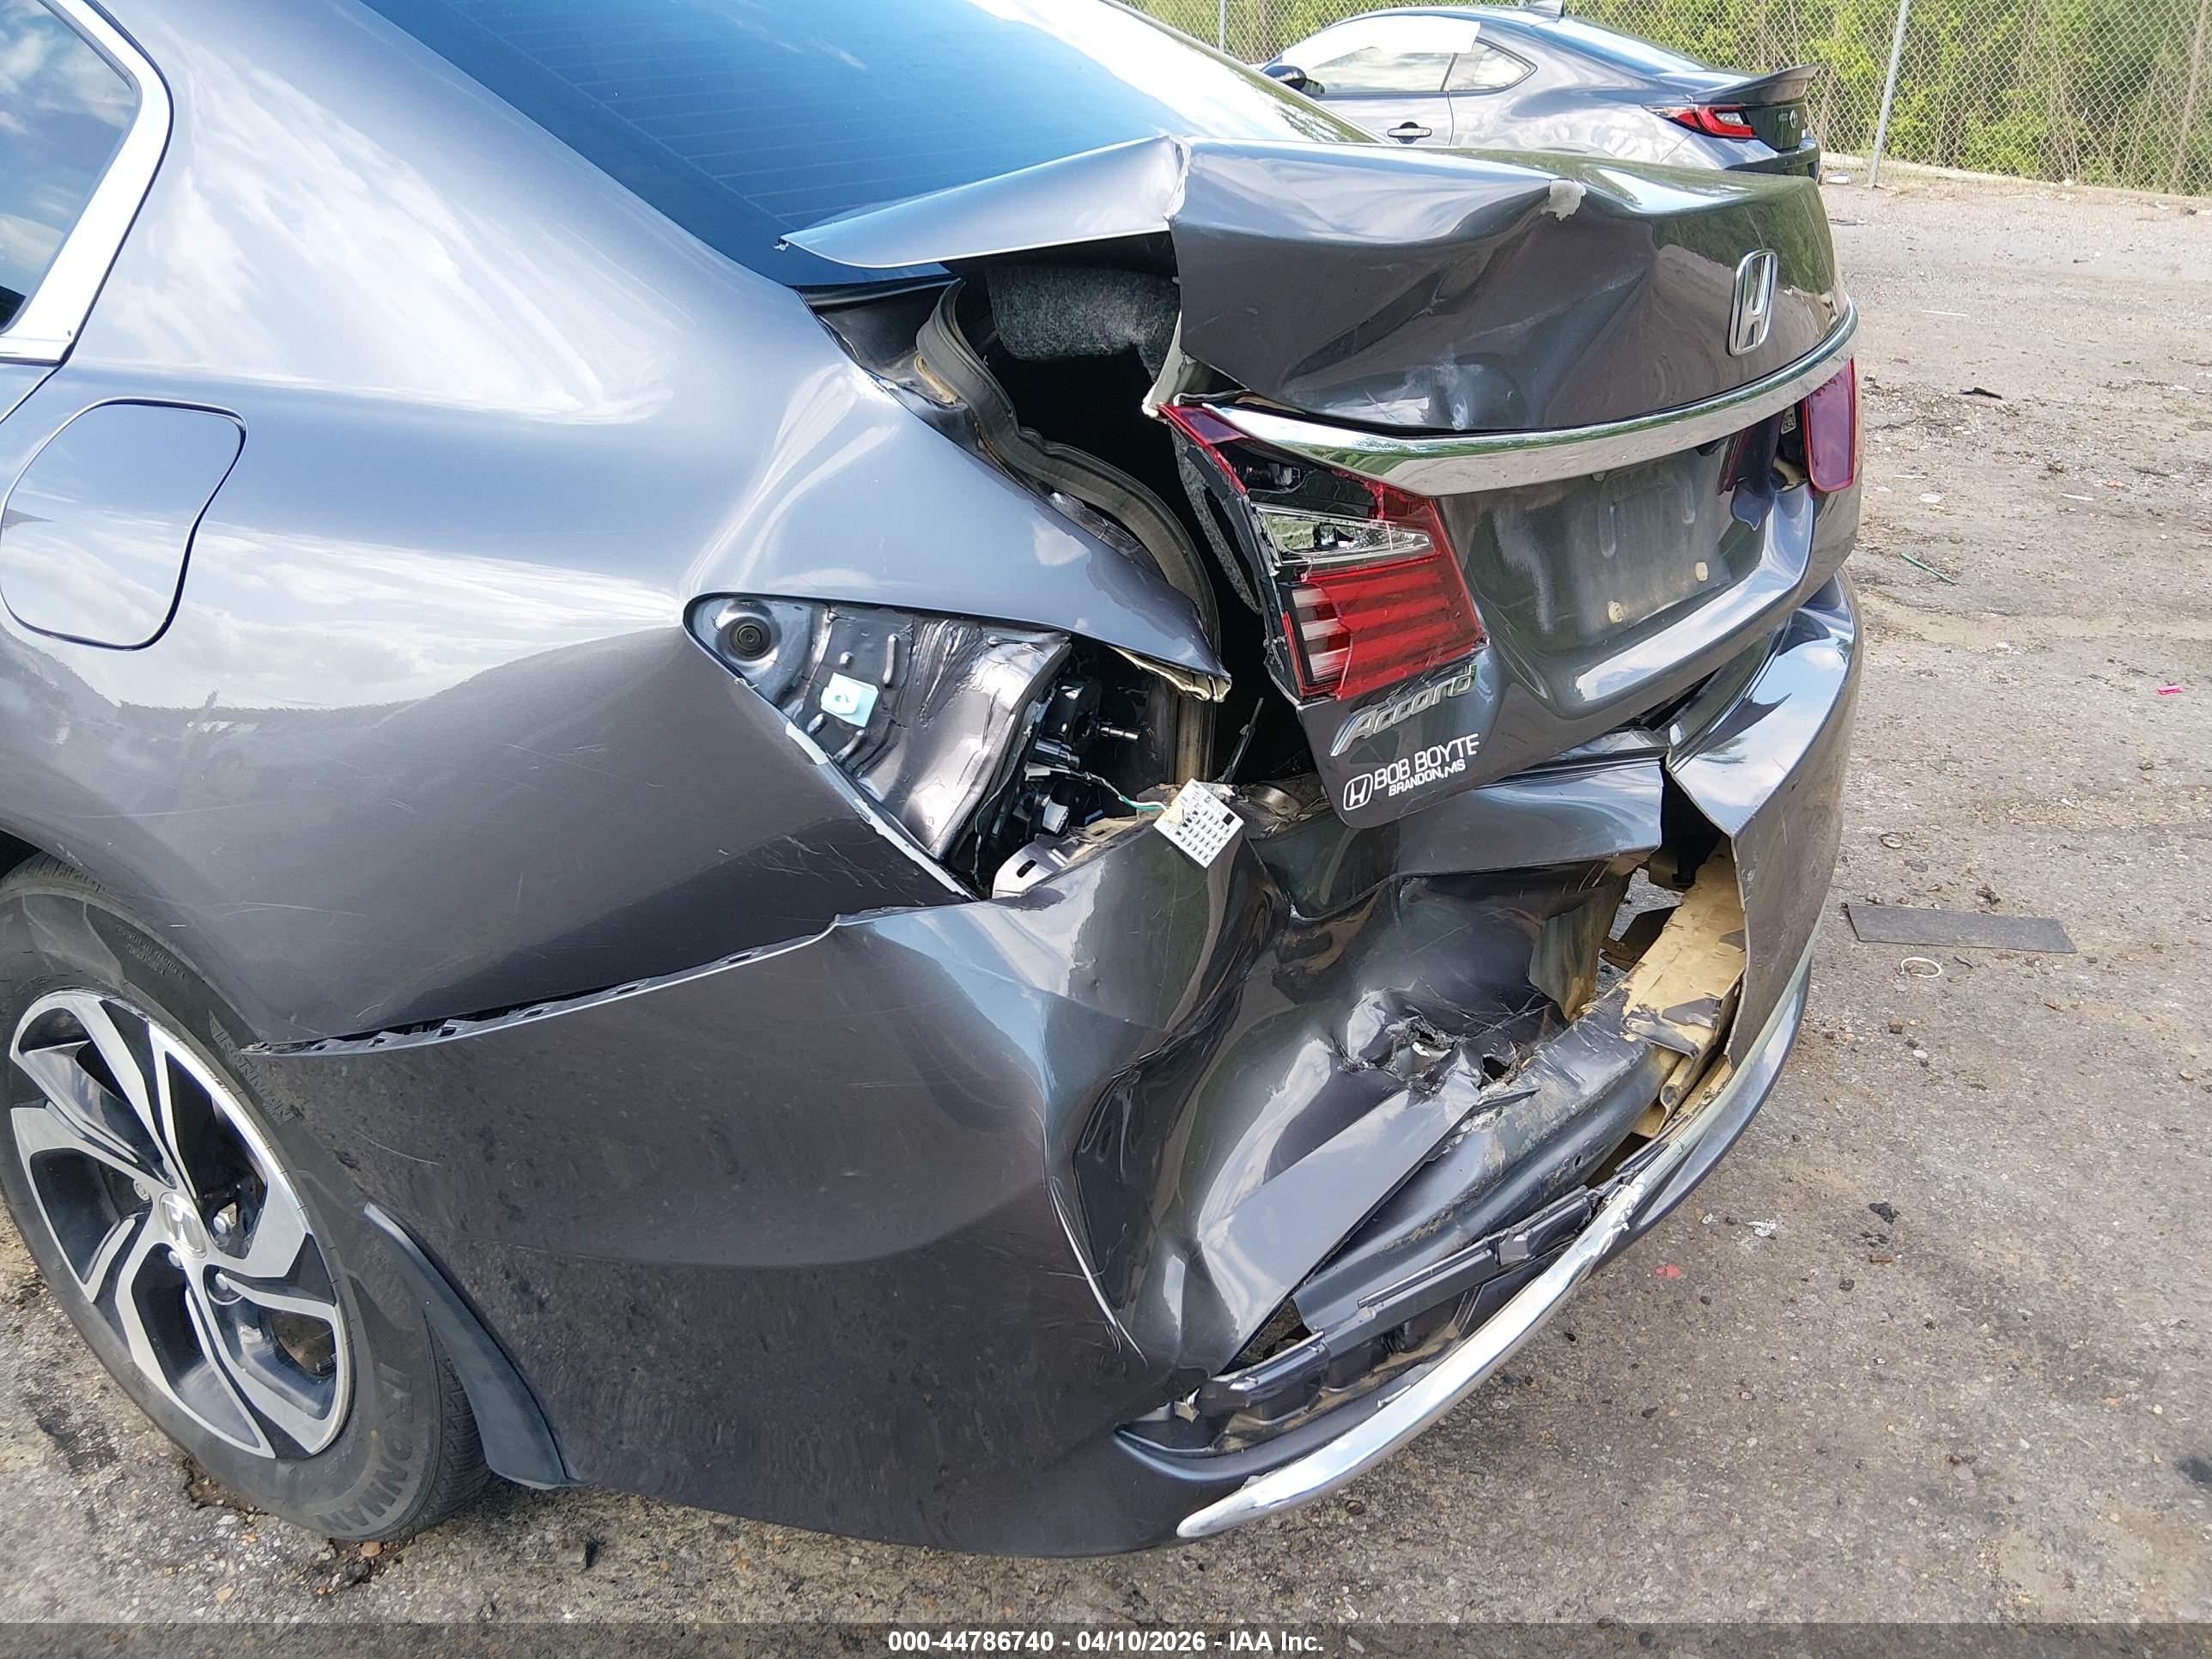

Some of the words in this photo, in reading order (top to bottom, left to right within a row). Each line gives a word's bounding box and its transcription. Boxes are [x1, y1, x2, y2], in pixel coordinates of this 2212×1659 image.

[1329, 663, 1477, 756] Accord
[1374, 758, 1411, 790] BOB
[1414, 733, 1480, 768] BOYTE
